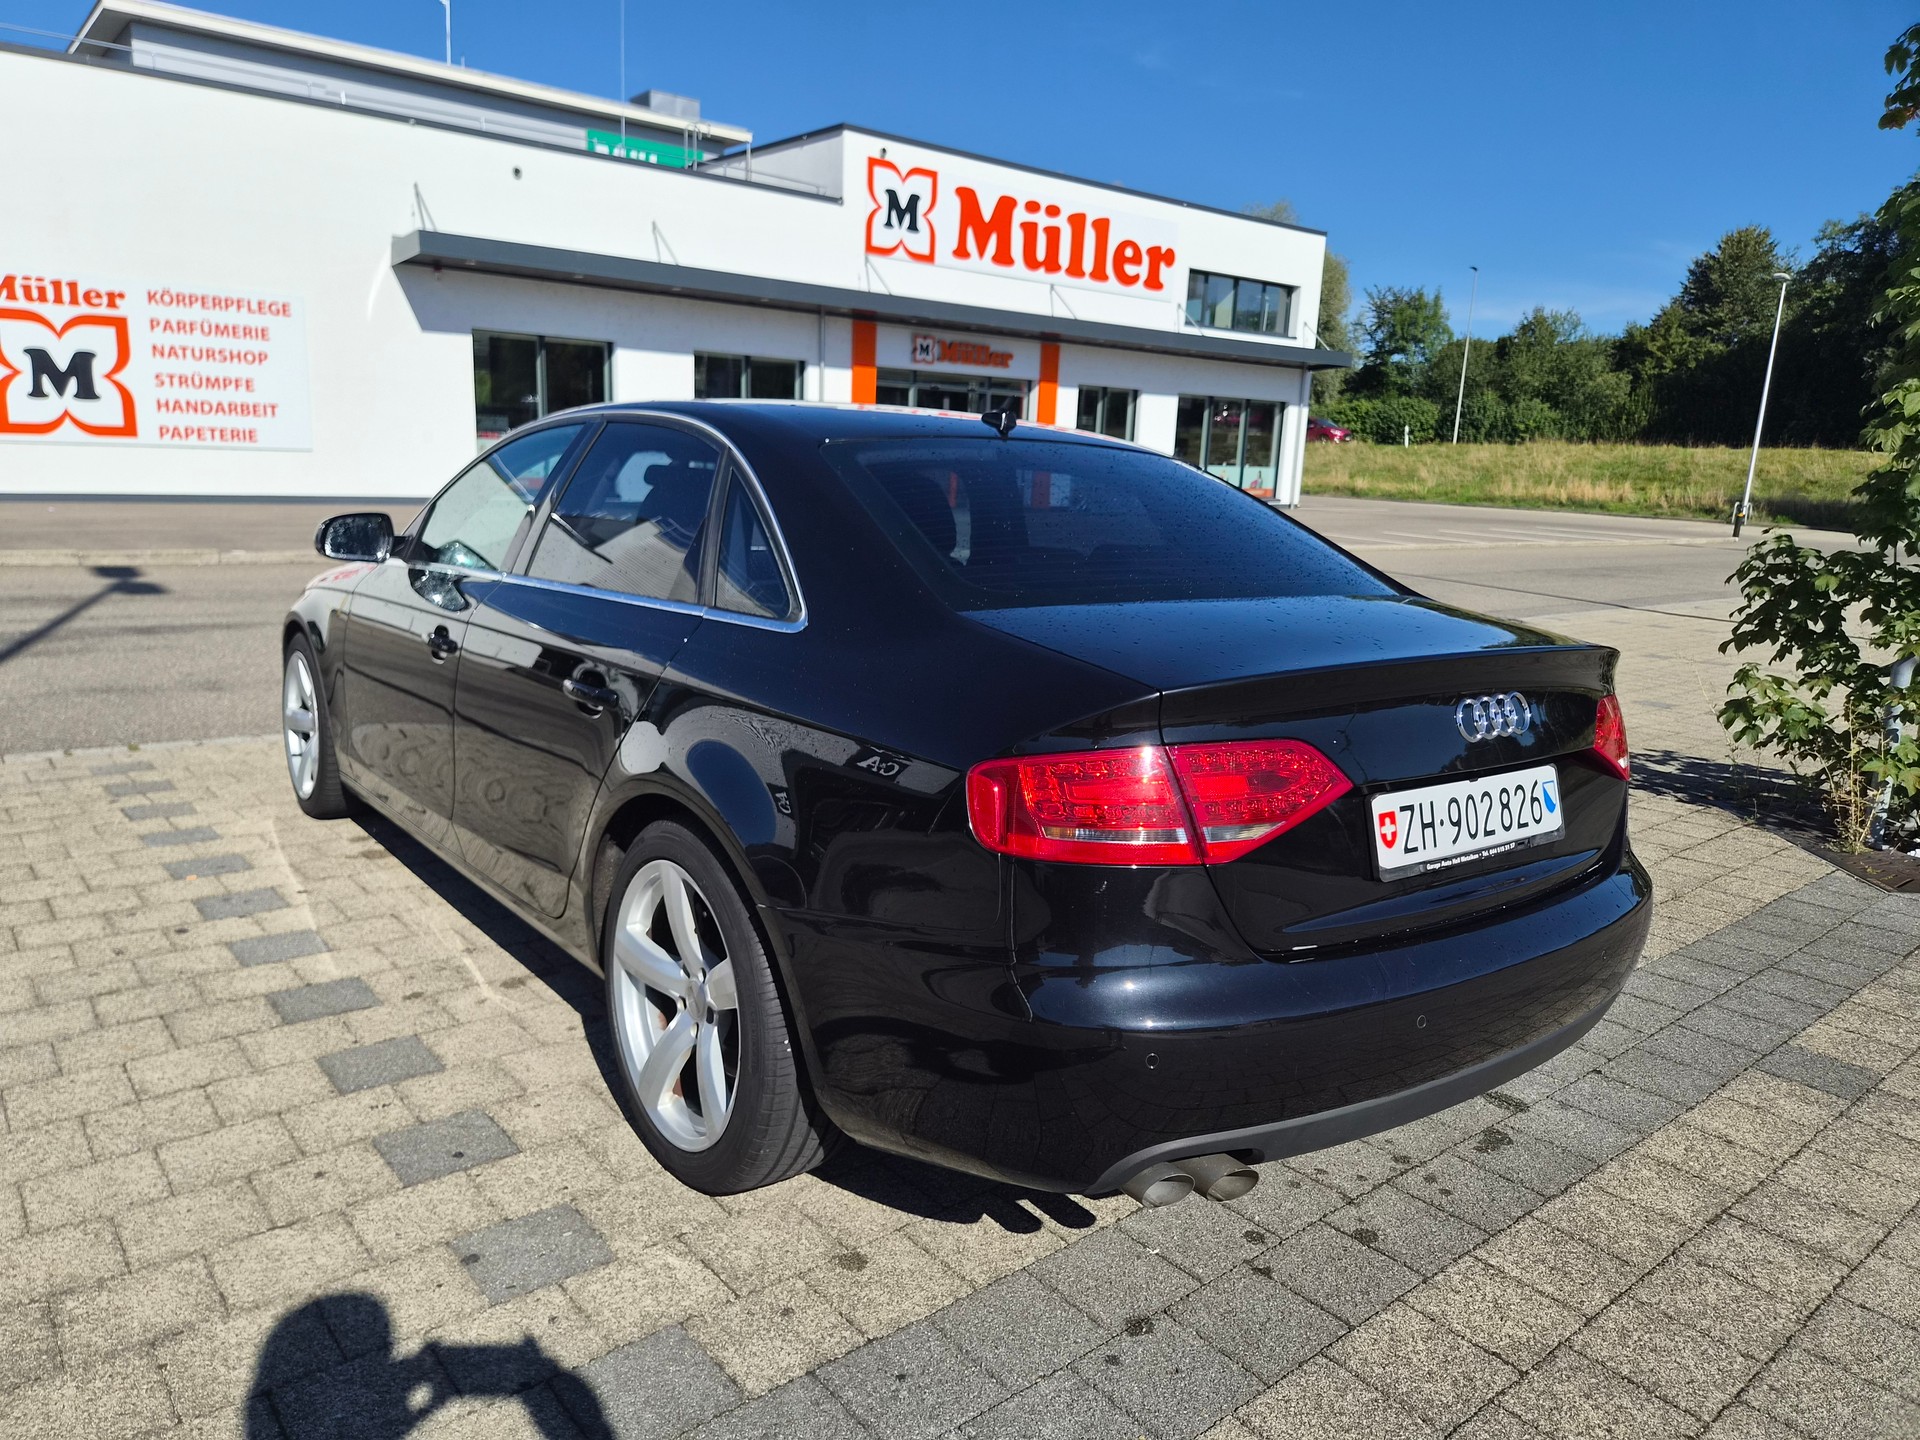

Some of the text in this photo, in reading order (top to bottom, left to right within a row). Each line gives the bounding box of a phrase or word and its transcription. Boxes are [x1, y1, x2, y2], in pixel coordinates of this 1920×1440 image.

[884, 186, 1176, 291] M Müller
[147, 288, 292, 318] KÖRPERPFLEGE
[149, 318, 270, 341] PARFÜMERIE
[152, 344, 268, 366] NATURSHOP
[939, 339, 1014, 368] Müller
[23, 346, 102, 400] M
[155, 372, 255, 393] STRÜMPFE
[157, 399, 278, 418] HANDARBEIT
[159, 425, 258, 443] PAPETERIE
